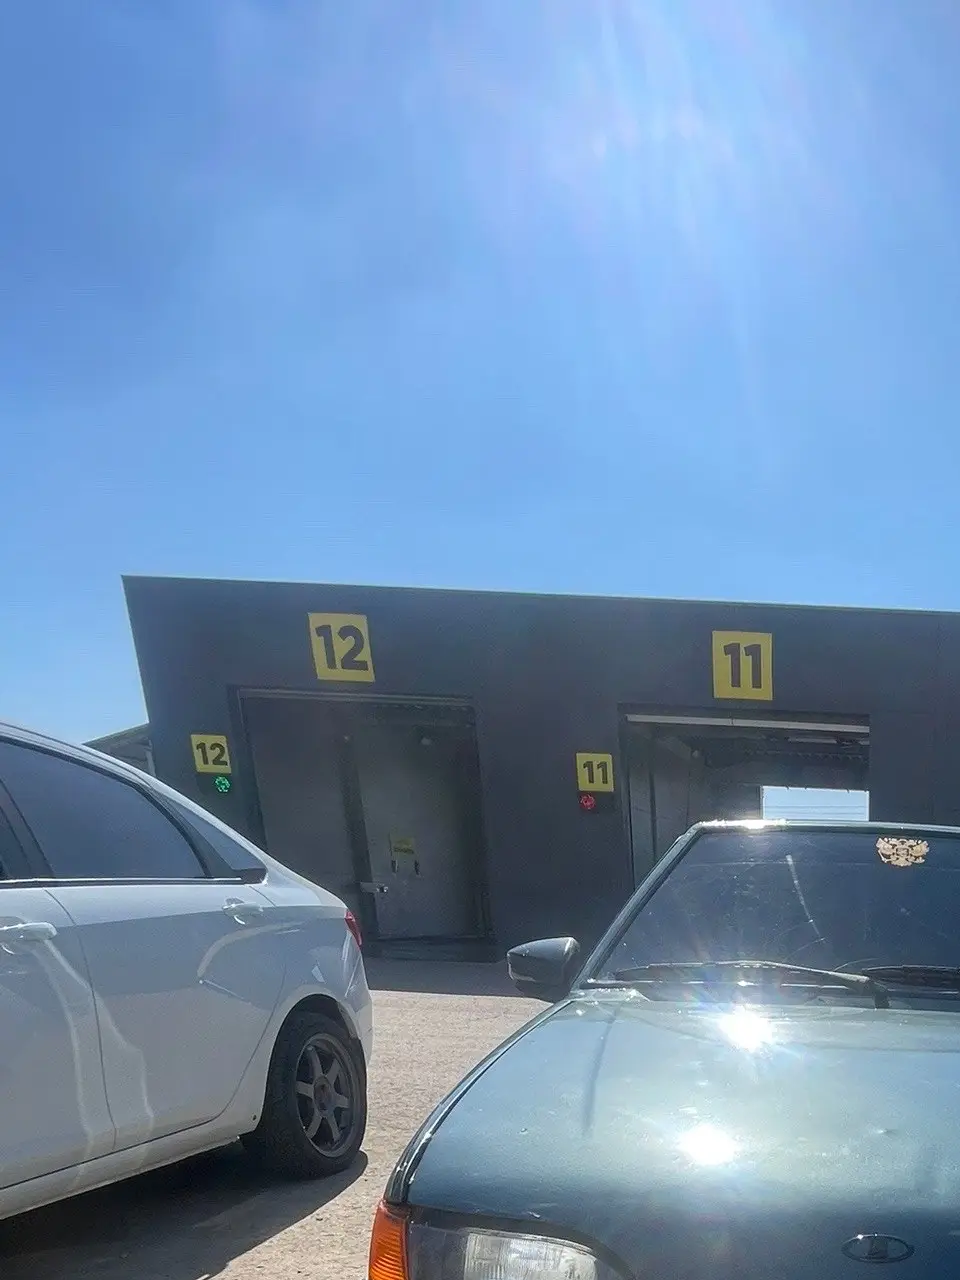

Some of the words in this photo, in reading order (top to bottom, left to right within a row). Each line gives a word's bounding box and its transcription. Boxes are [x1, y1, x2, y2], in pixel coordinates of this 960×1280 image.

[315, 624, 369, 671] 12
[722, 642, 762, 689] 11
[195, 741, 229, 766] 12
[583, 760, 609, 785] 11
